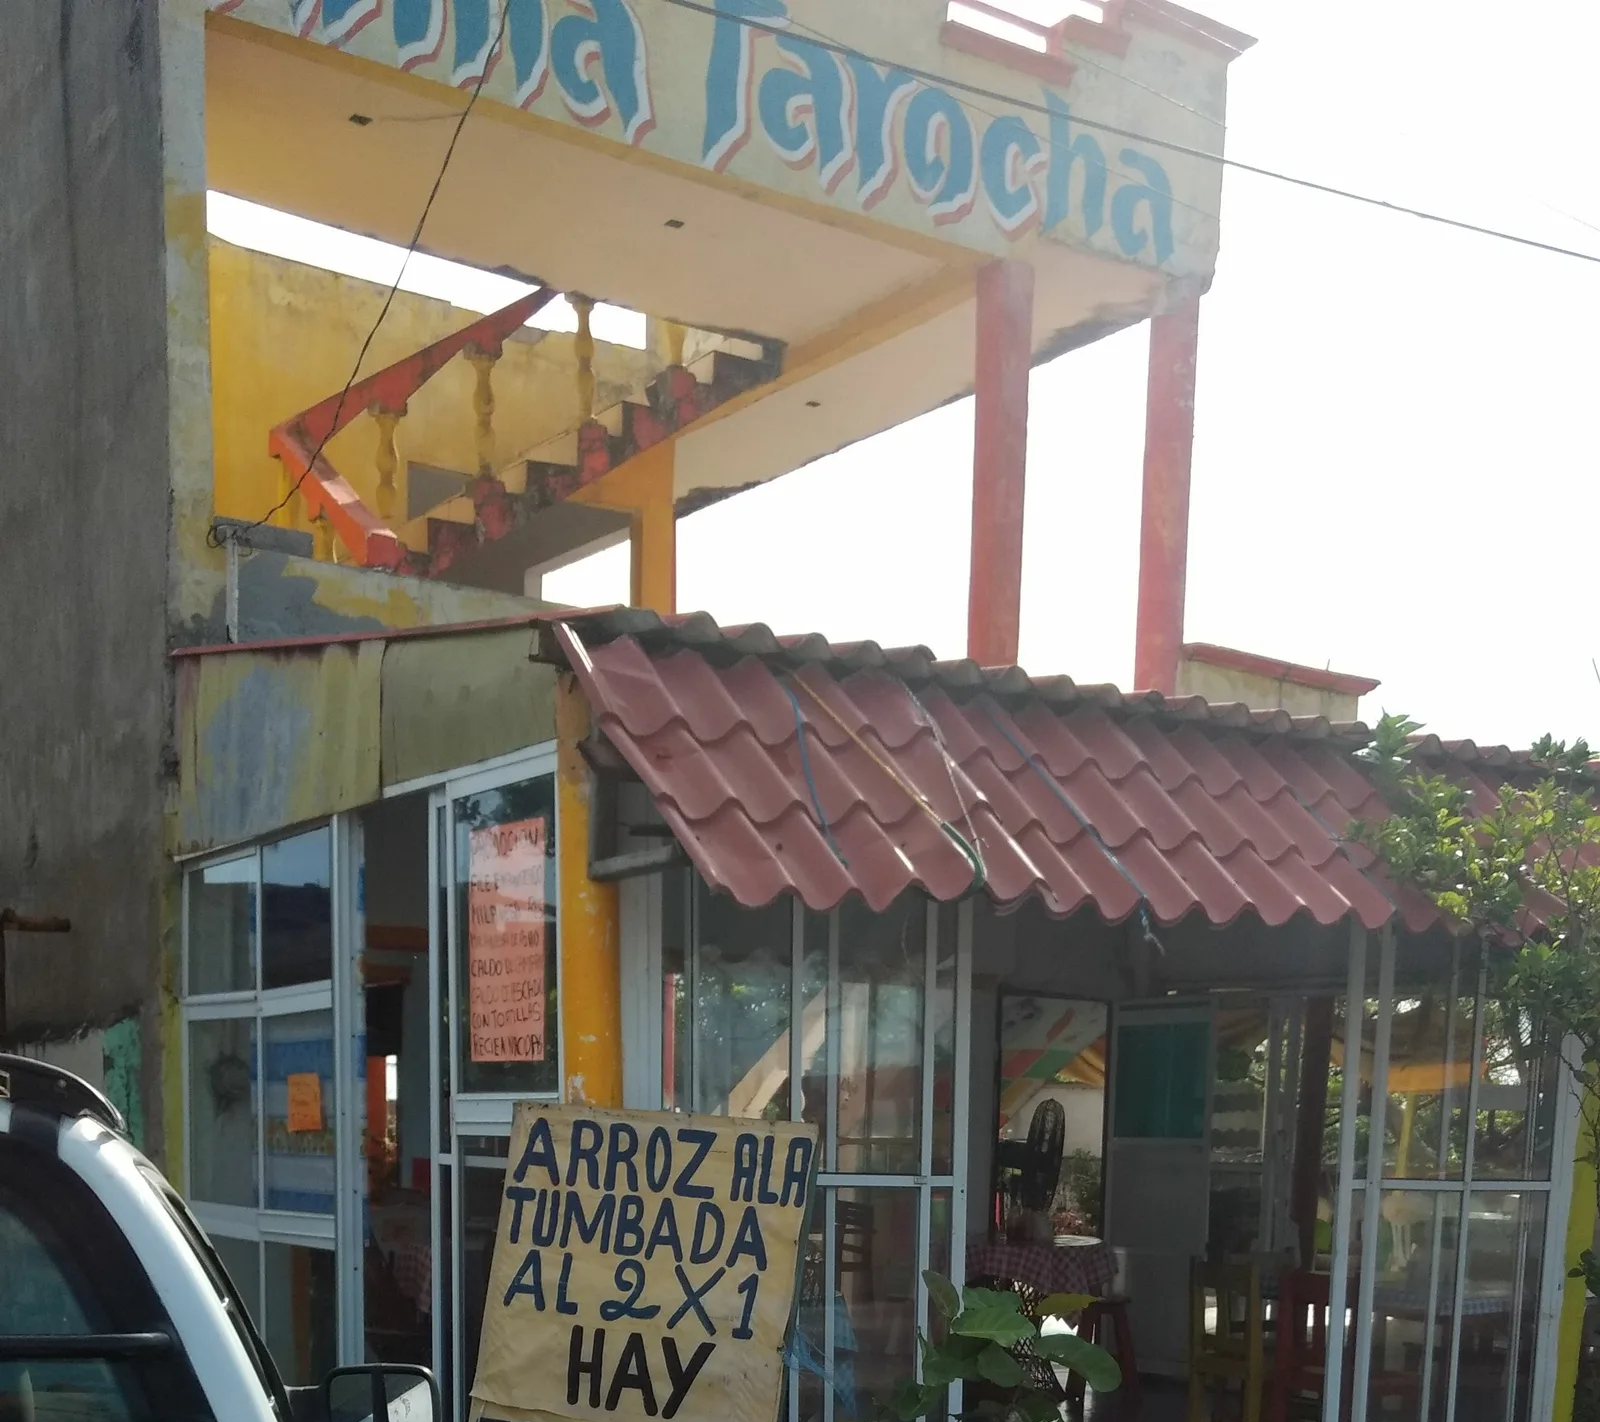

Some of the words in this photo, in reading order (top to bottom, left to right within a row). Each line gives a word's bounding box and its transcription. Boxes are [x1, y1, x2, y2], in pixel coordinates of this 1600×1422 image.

[471, 959, 502, 978] CALDO
[471, 1011, 489, 1029] CON
[513, 1117, 717, 1200] ARROZ
[505, 1186, 768, 1272] TUMBADA
[503, 1249, 578, 1315] AL
[566, 1324, 716, 1420] HAY
